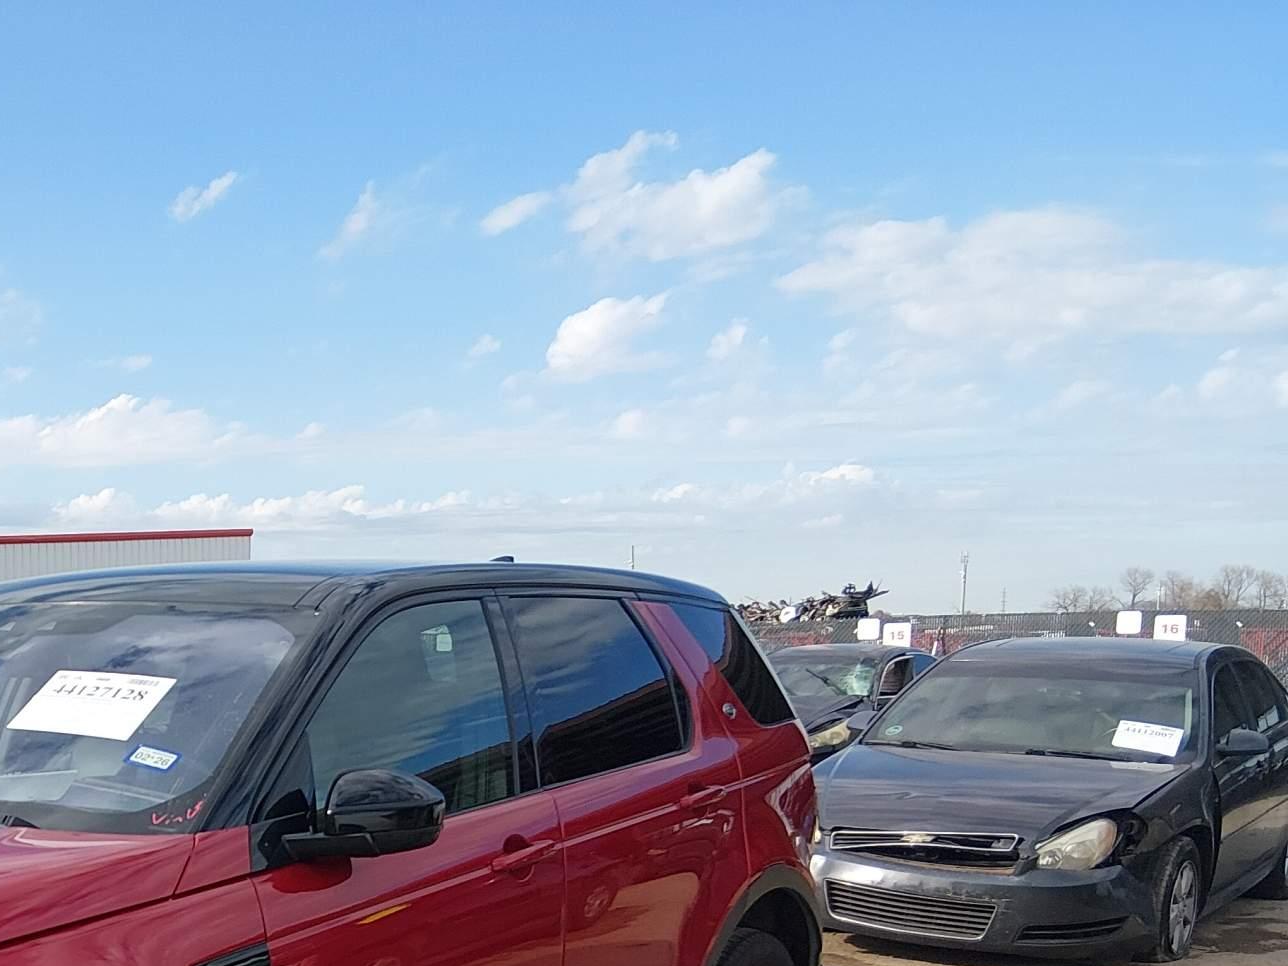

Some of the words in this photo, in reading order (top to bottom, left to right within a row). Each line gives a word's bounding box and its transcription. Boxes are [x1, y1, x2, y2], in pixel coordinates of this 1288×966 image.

[1162, 624, 1180, 634] 16
[889, 631, 905, 641] 15
[53, 683, 149, 701] 44127128
